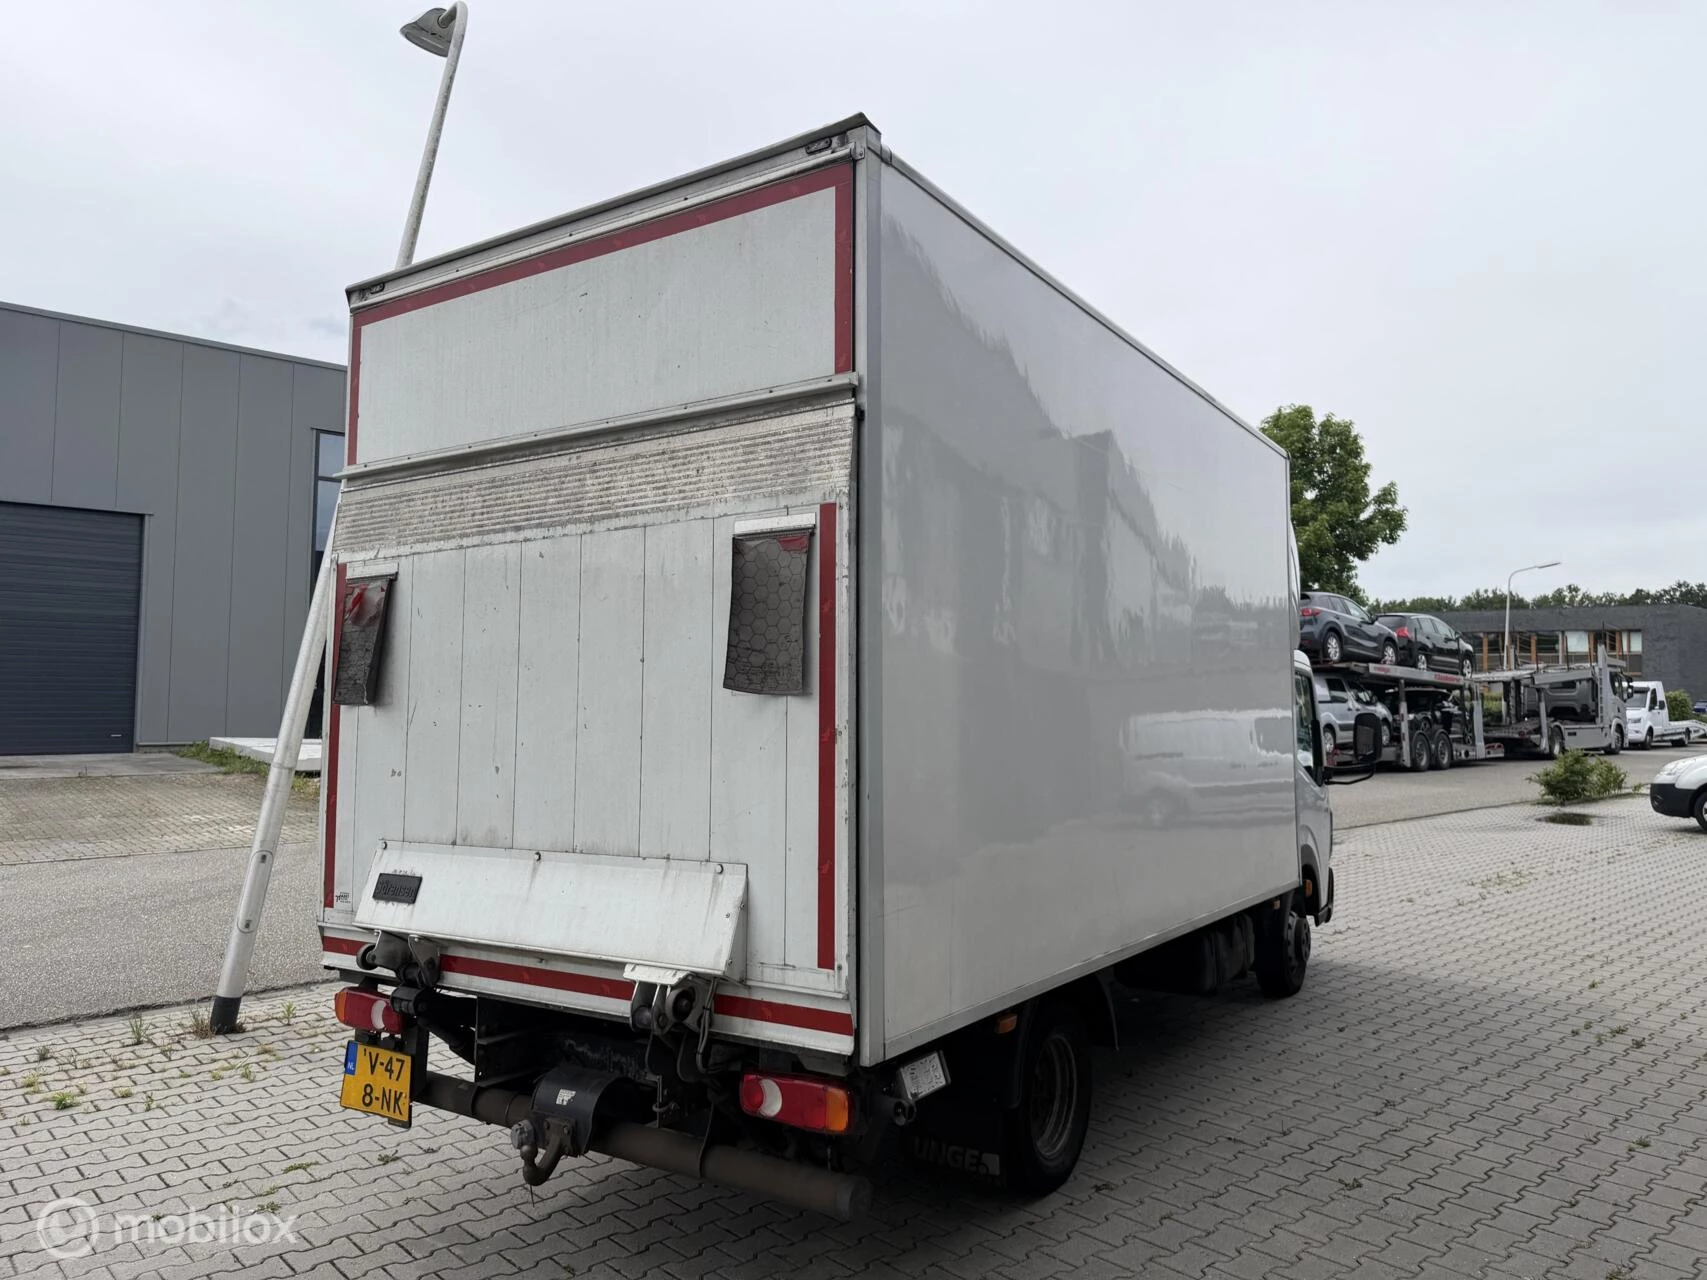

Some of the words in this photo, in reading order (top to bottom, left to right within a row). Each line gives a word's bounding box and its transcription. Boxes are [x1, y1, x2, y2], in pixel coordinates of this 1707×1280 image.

[347, 1061, 355, 1071] NL
[368, 1051, 406, 1082] V-47
[362, 1083, 404, 1116] 8-NK
